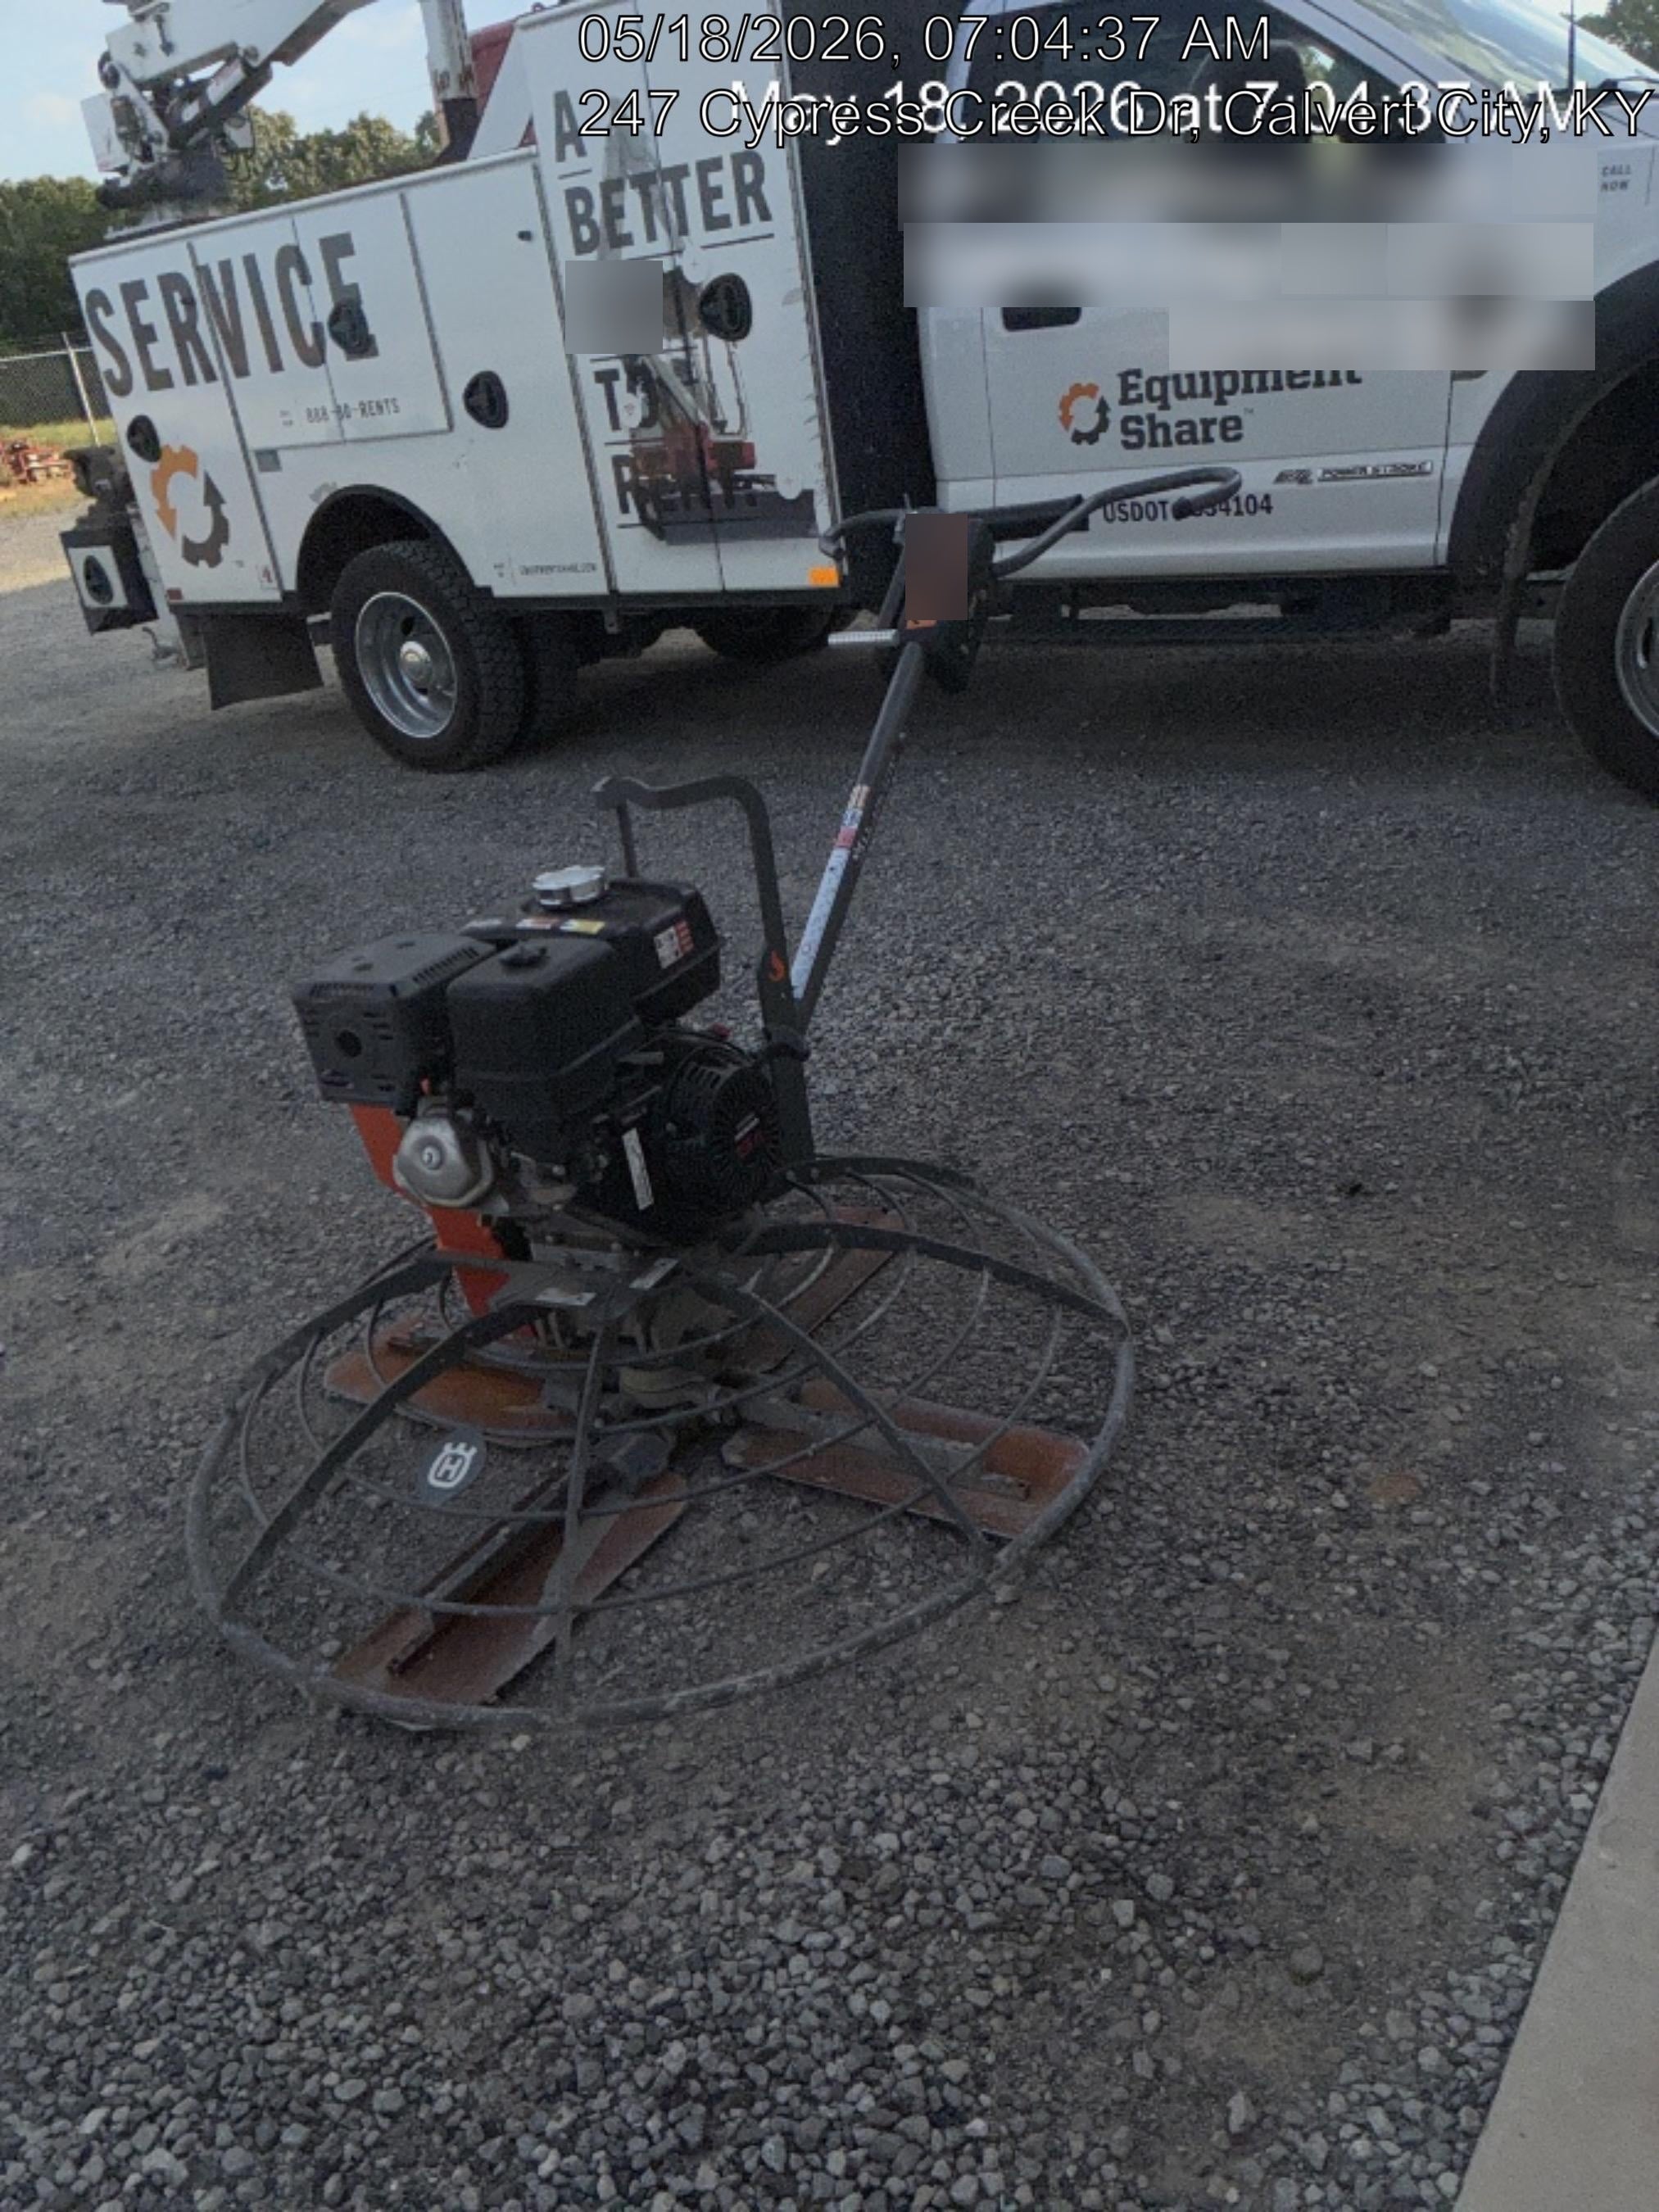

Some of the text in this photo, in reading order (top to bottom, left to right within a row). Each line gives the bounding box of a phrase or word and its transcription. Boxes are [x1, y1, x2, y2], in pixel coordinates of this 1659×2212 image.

[554, 89, 587, 163] A
[564, 150, 773, 256] BETTER
[84, 232, 379, 397] SERVICE
[1120, 413, 1244, 450] Share
[1103, 501, 1169, 523] USDOT
